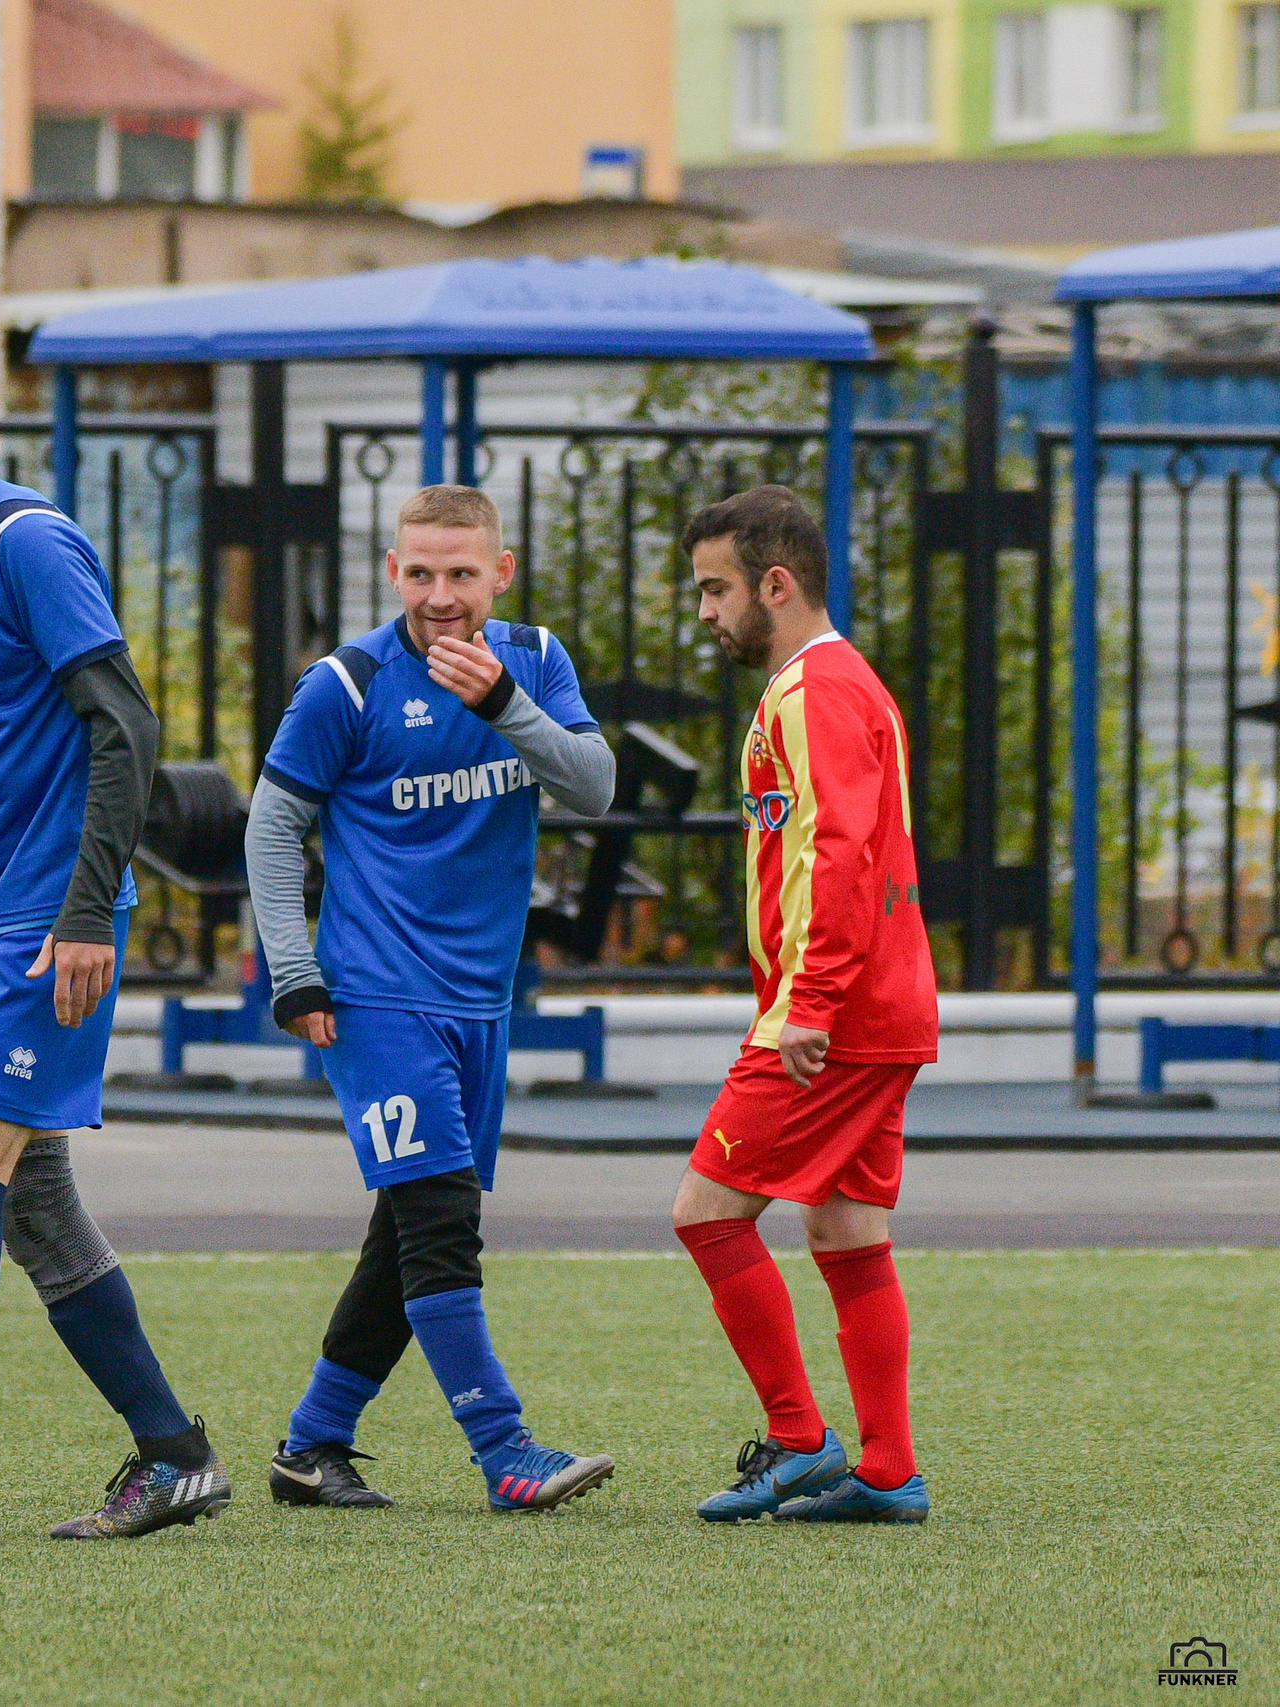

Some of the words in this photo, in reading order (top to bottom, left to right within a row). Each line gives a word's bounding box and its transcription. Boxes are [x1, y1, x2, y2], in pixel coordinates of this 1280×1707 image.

[404, 715, 434, 728] errea
[3, 1063, 33, 1080] errea
[361, 1094, 426, 1163] 12
